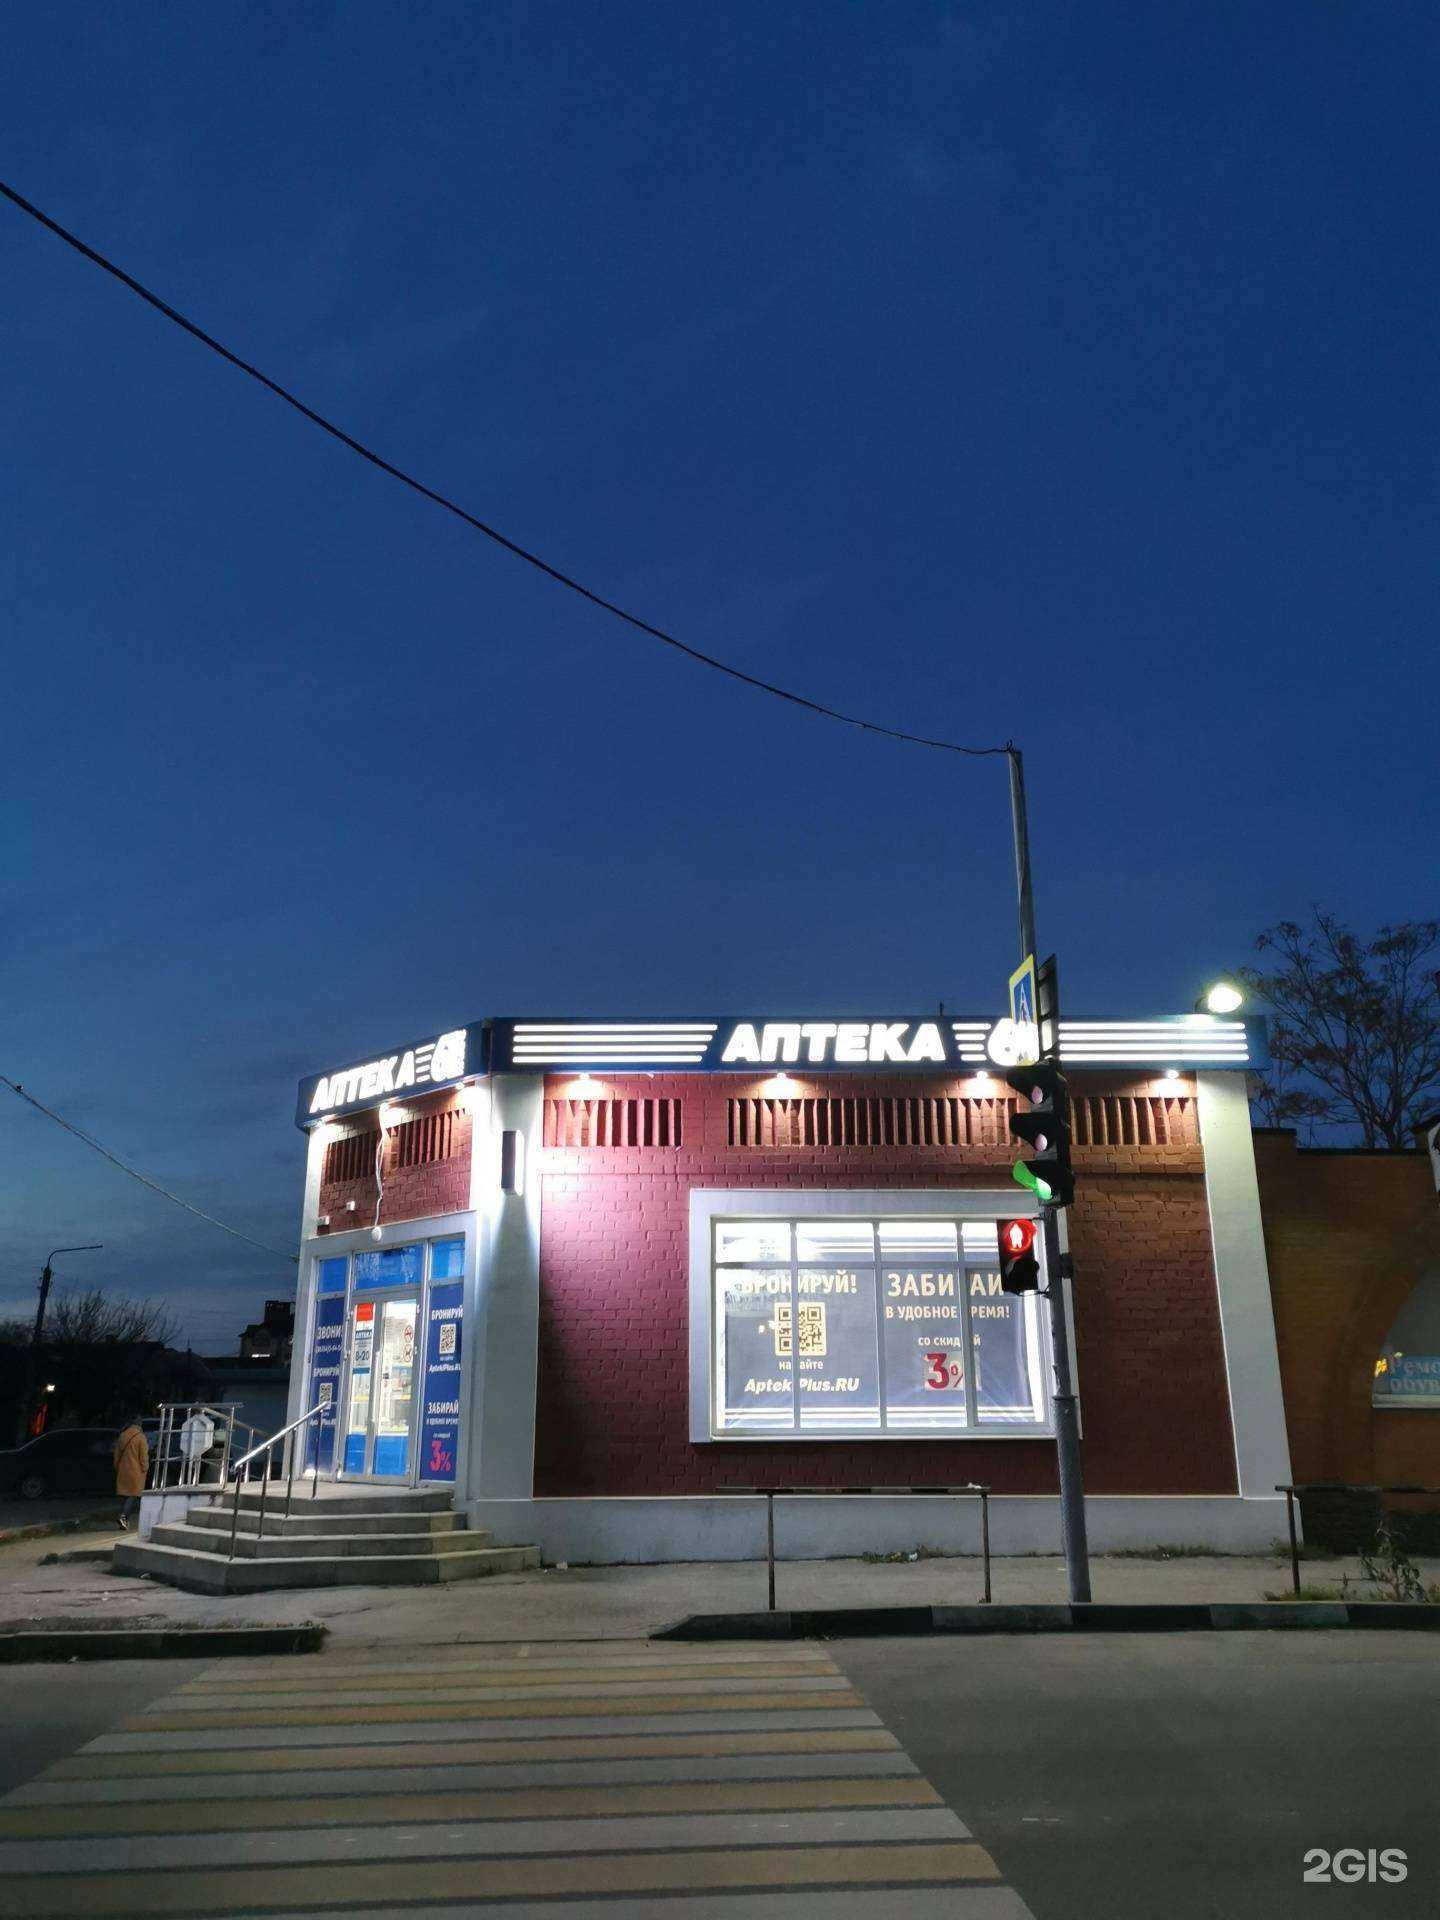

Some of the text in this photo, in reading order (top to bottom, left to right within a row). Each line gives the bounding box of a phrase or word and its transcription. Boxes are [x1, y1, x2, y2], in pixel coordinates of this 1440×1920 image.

[721, 1023, 947, 1063] АПТЕКА
[309, 1051, 416, 1114] АПТЕКА
[886, 1305, 1011, 1321] В УДОБНОЕ РЕМЯ!
[799, 1359, 824, 1370] айте
[743, 1377, 860, 1395] AptekPlus.RU
